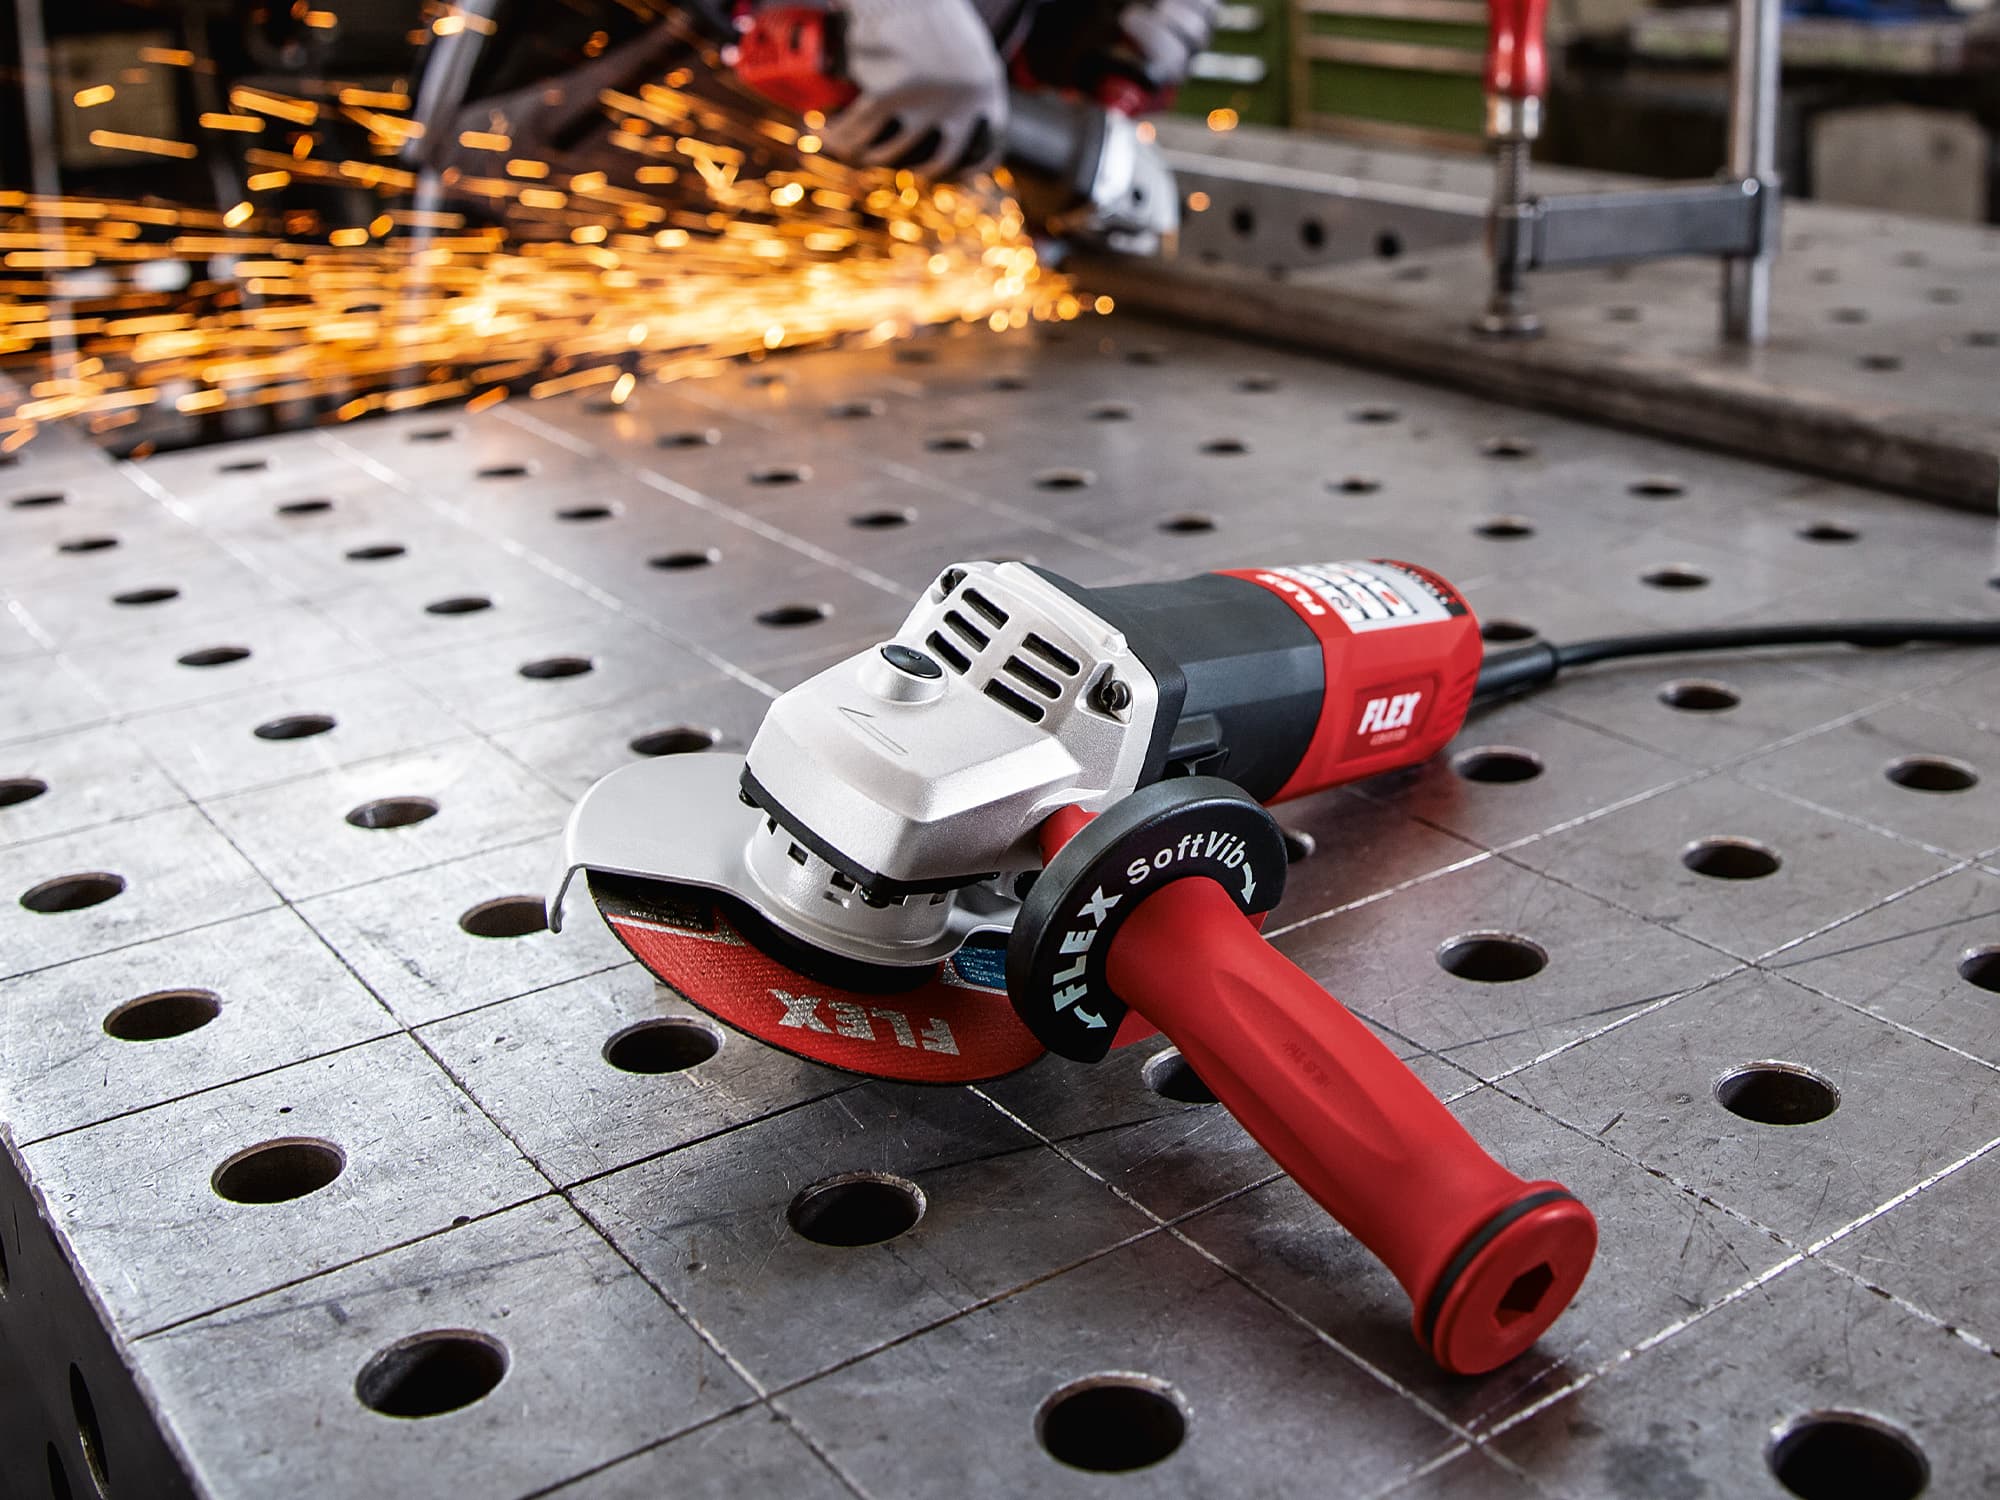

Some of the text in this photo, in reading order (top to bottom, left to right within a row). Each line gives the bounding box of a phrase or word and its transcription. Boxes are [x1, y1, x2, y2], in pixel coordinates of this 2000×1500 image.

[1357, 691, 1422, 736] FLEX
[1052, 884, 1124, 1012] FLEX
[1126, 830, 1246, 885] SoftVib
[767, 987, 961, 1057] FLEX
